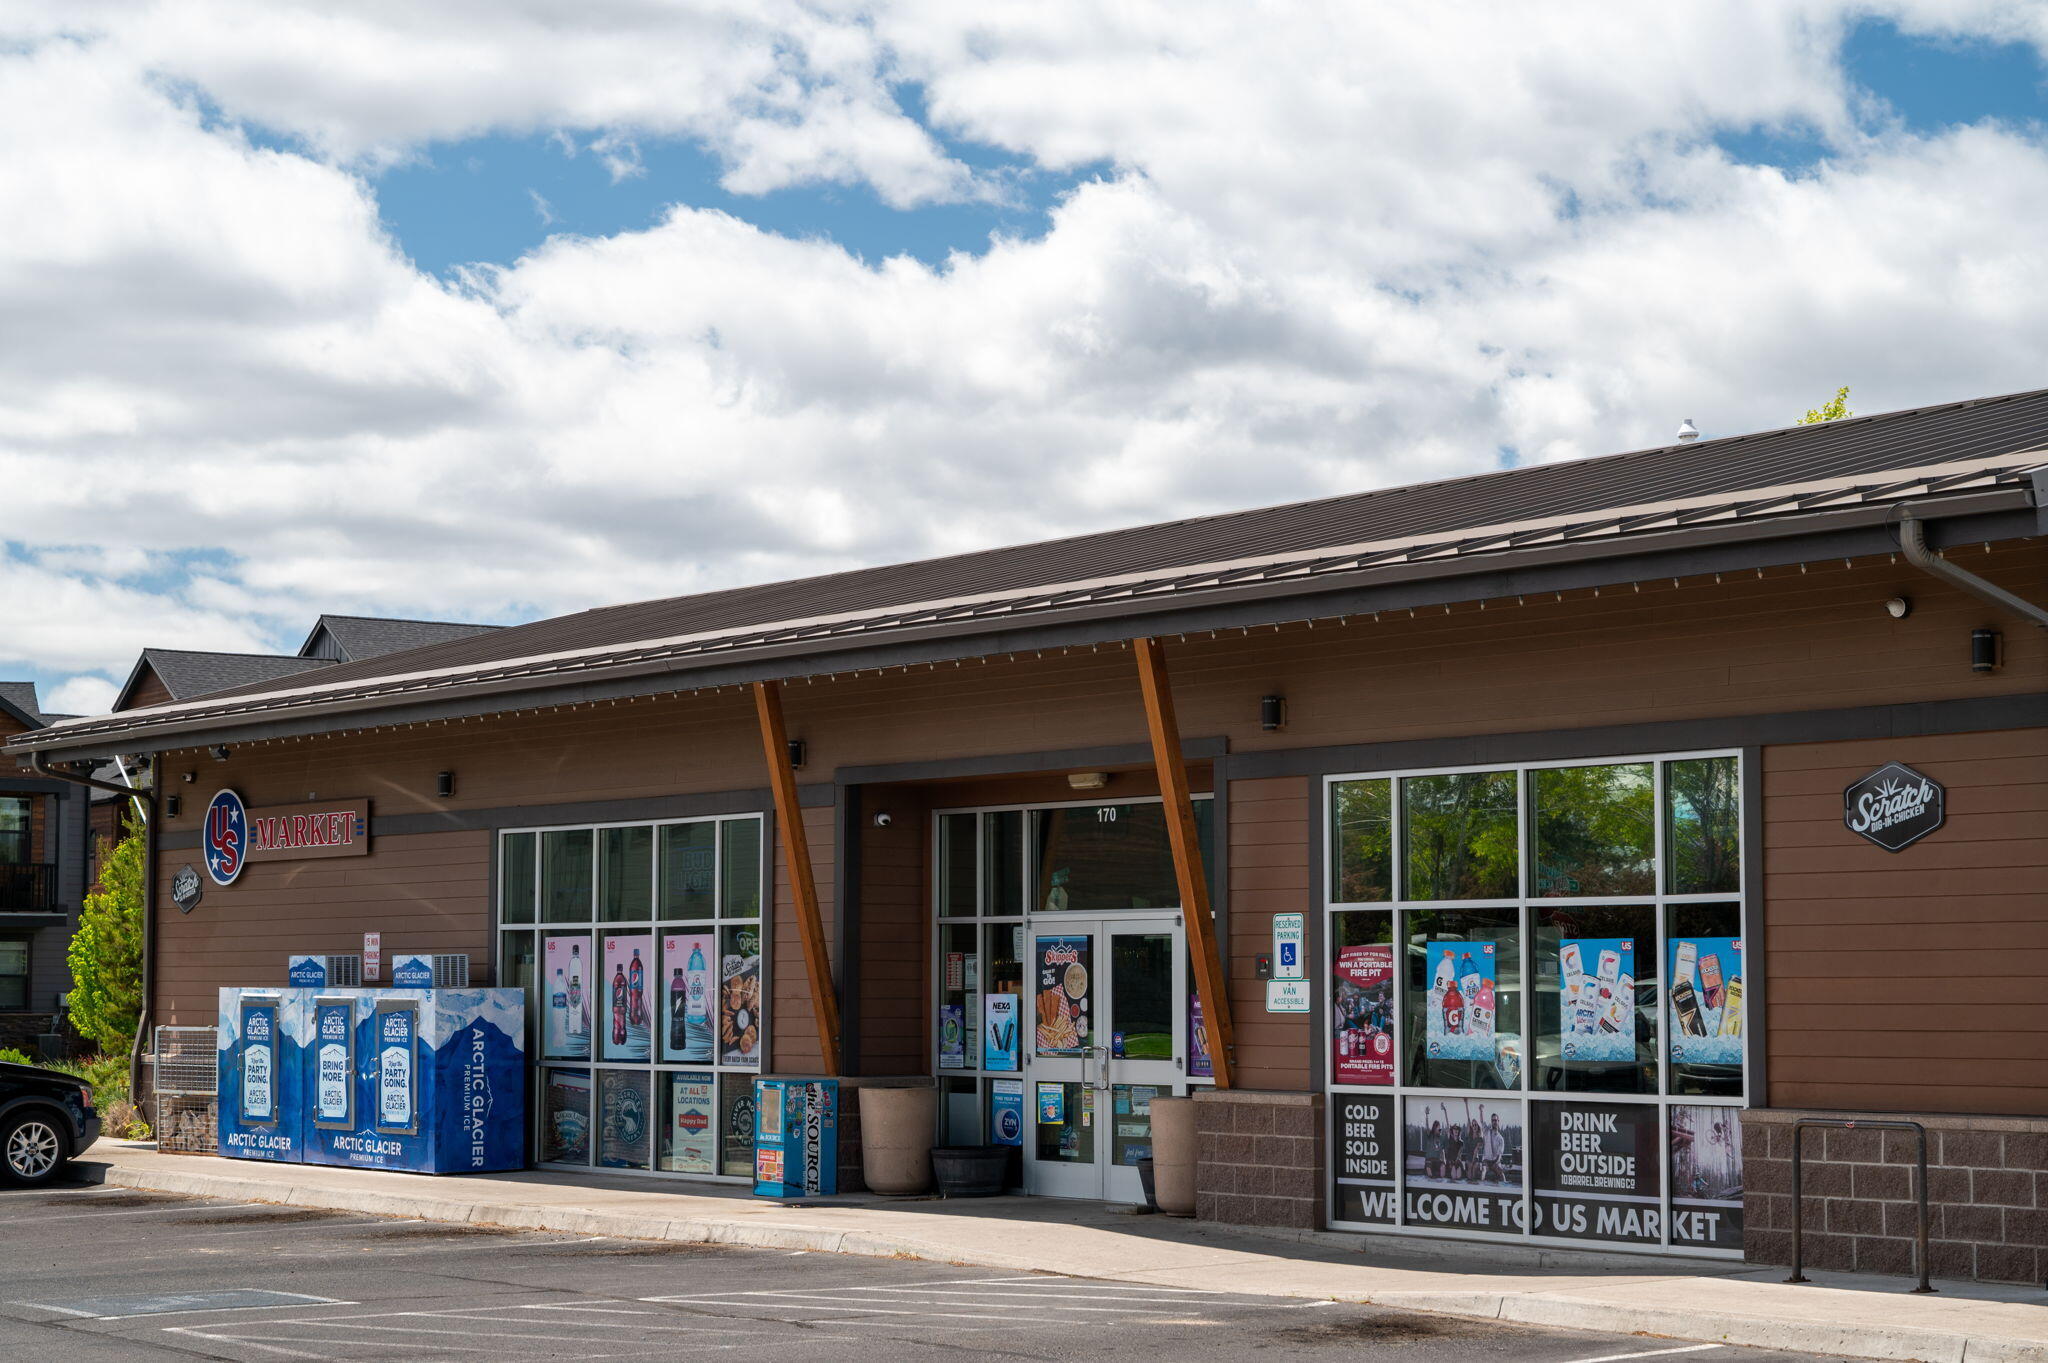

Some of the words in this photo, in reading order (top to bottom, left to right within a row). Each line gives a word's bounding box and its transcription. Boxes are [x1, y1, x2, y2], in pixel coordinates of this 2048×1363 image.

[1852, 778, 1933, 832] Scratch
[1097, 808, 1116, 822] 170
[256, 811, 356, 850] MARKET
[211, 805, 239, 875] US
[1275, 920, 1300, 928] RESERVED
[1276, 932, 1300, 940] PARKING
[739, 938, 759, 950] OPE
[1622, 942, 1632, 950] US
[1484, 945, 1494, 954] US
[1436, 976, 1443, 986] G
[690, 986, 704, 995] ZERO
[1283, 987, 1296, 995] VAN
[1448, 1010, 1458, 1025] G
[1474, 1008, 1482, 1017] G
[248, 1018, 268, 1026] ARCTIC
[324, 1016, 344, 1025] ARCTIC
[385, 1018, 407, 1027] ARCTIC
[247, 1026, 269, 1035] GLACIER
[322, 1025, 345, 1034] GLACIER
[384, 1027, 408, 1036] GLACIER
[472, 1028, 485, 1091] ARCTIC
[248, 1065, 267, 1074] PARTY
[323, 1060, 343, 1071] BRING
[322, 1072, 343, 1082] MORE.
[385, 1068, 407, 1078] PARTY
[247, 1074, 268, 1084] GOING.
[384, 1078, 407, 1088] GOING.
[324, 1090, 341, 1098] ARCTIC
[689, 1087, 700, 1095] ALL
[248, 1096, 266, 1104] GLACIER
[323, 1097, 343, 1106] GLACIER
[386, 1094, 405, 1102] ARCTIC
[678, 1096, 710, 1105] LOCATIONS
[385, 1101, 406, 1110] GLACIER
[1345, 1104, 1379, 1120] COLD
[680, 1117, 696, 1126] Happy
[1004, 1118, 1017, 1128] ZYN
[1561, 1112, 1618, 1133] DRINK
[472, 1095, 484, 1167] GLACIER
[1345, 1123, 1375, 1138] BEER
[228, 1133, 256, 1147] ARCTIC
[259, 1135, 291, 1150] GLACIER
[333, 1136, 363, 1151] ARCTIC
[365, 1139, 402, 1156] GLACIER
[1561, 1133, 1602, 1153] BEER
[243, 1149, 265, 1157] PREMIUM
[266, 1150, 274, 1158] ICE
[806, 1114, 820, 1192] SOURCE
[1345, 1141, 1379, 1156] SOLD
[350, 1152, 373, 1163] PREMIUM
[375, 1156, 384, 1164] ICE
[1345, 1159, 1388, 1175] INSIDE
[1561, 1153, 1635, 1176] OUTSIDE
[1360, 1191, 1489, 1225] WELCOME
[1498, 1199, 1543, 1229] TO
[1552, 1203, 1587, 1233] US
[1596, 1206, 1720, 1241] MARKET
